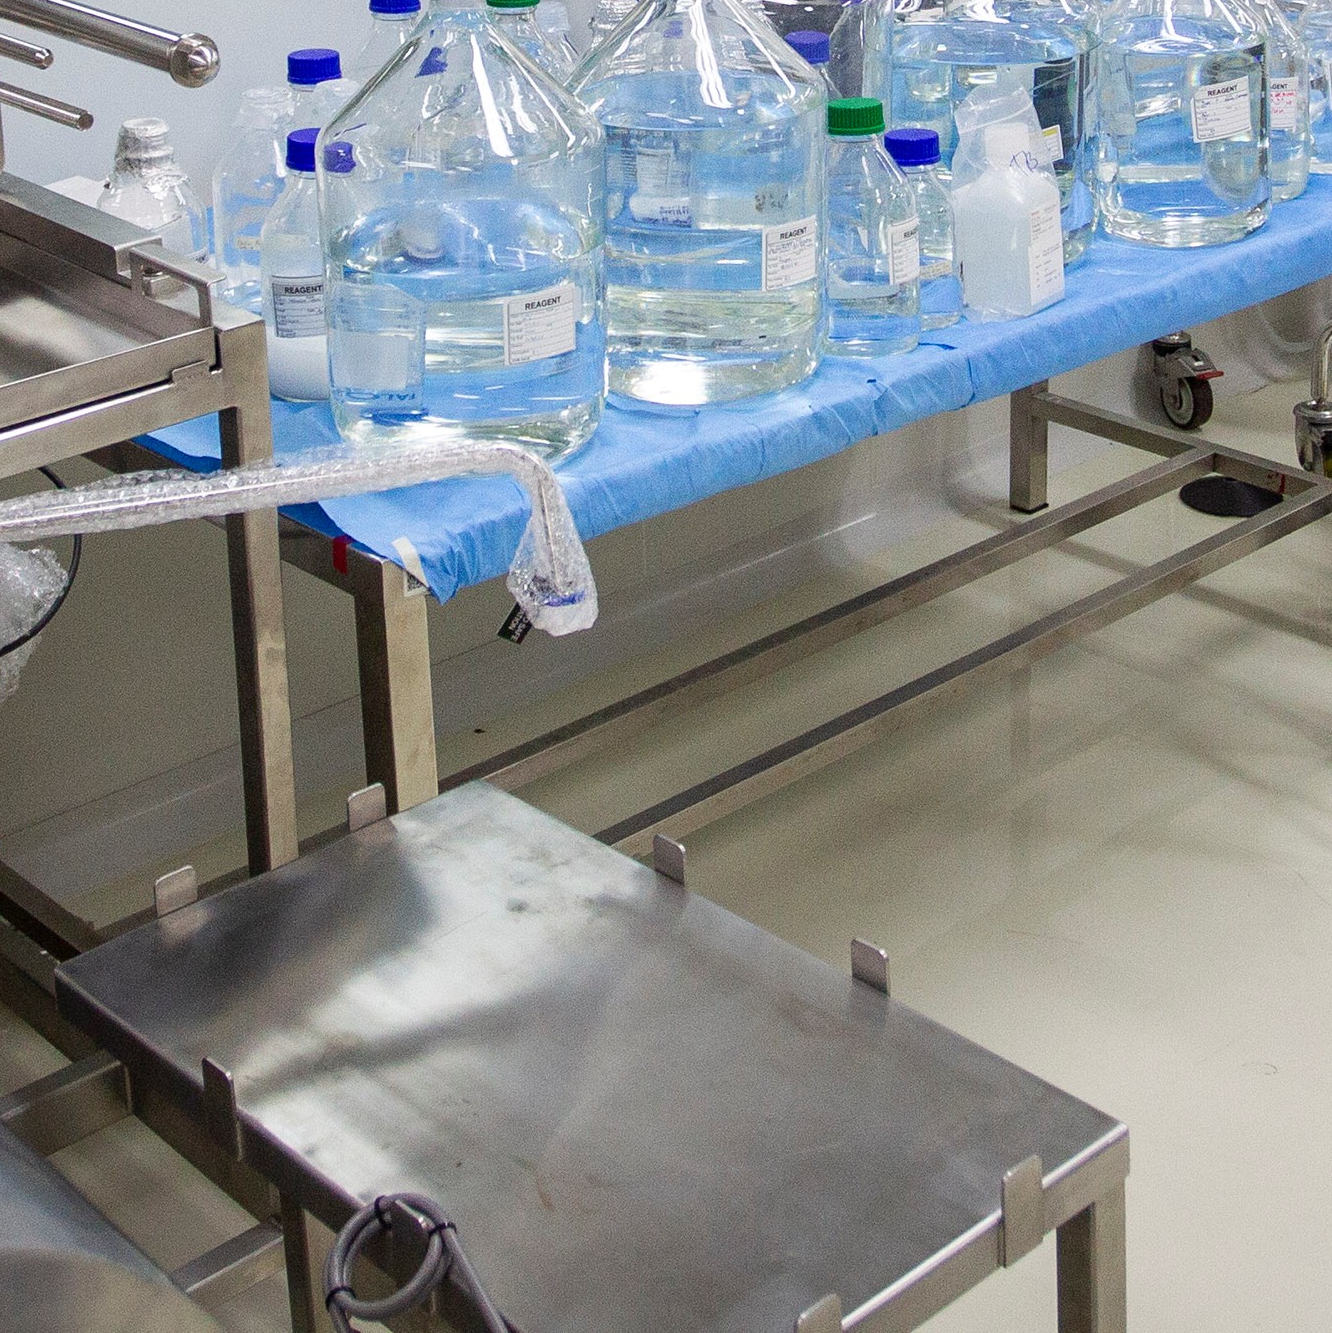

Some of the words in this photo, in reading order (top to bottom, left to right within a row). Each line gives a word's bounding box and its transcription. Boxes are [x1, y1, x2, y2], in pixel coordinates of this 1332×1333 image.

[1207, 85, 1239, 97] REAGENT
[779, 226, 808, 240] REAGENT
[284, 285, 324, 294] REAGENT
[524, 295, 562, 311] REAGENT
